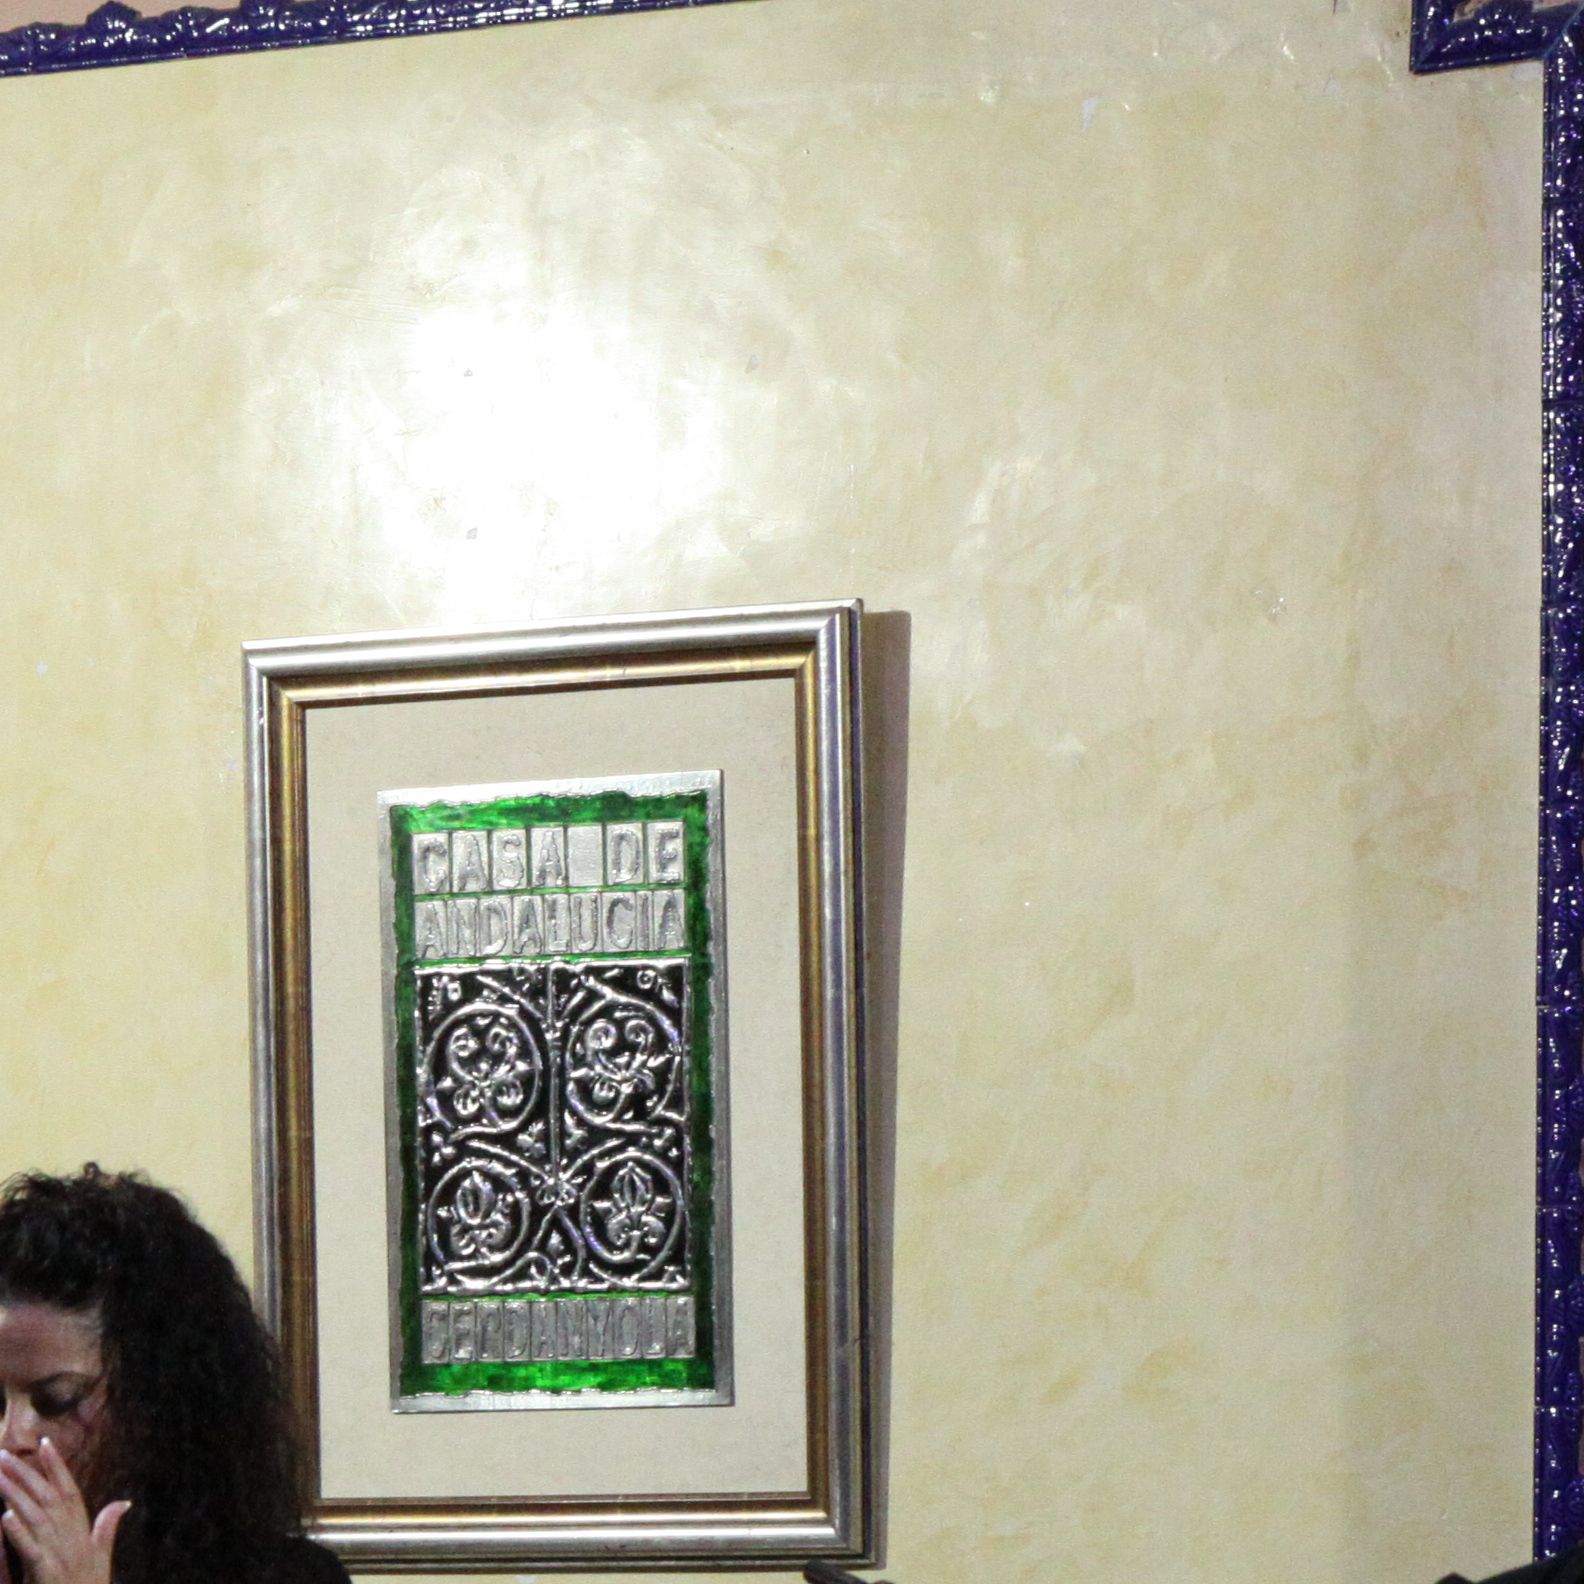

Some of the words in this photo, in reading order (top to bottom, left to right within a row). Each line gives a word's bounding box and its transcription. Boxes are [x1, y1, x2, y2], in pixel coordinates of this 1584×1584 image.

[419, 831, 564, 891] CASA
[611, 828, 682, 884] DE
[419, 889, 683, 958] ANDALUCIA
